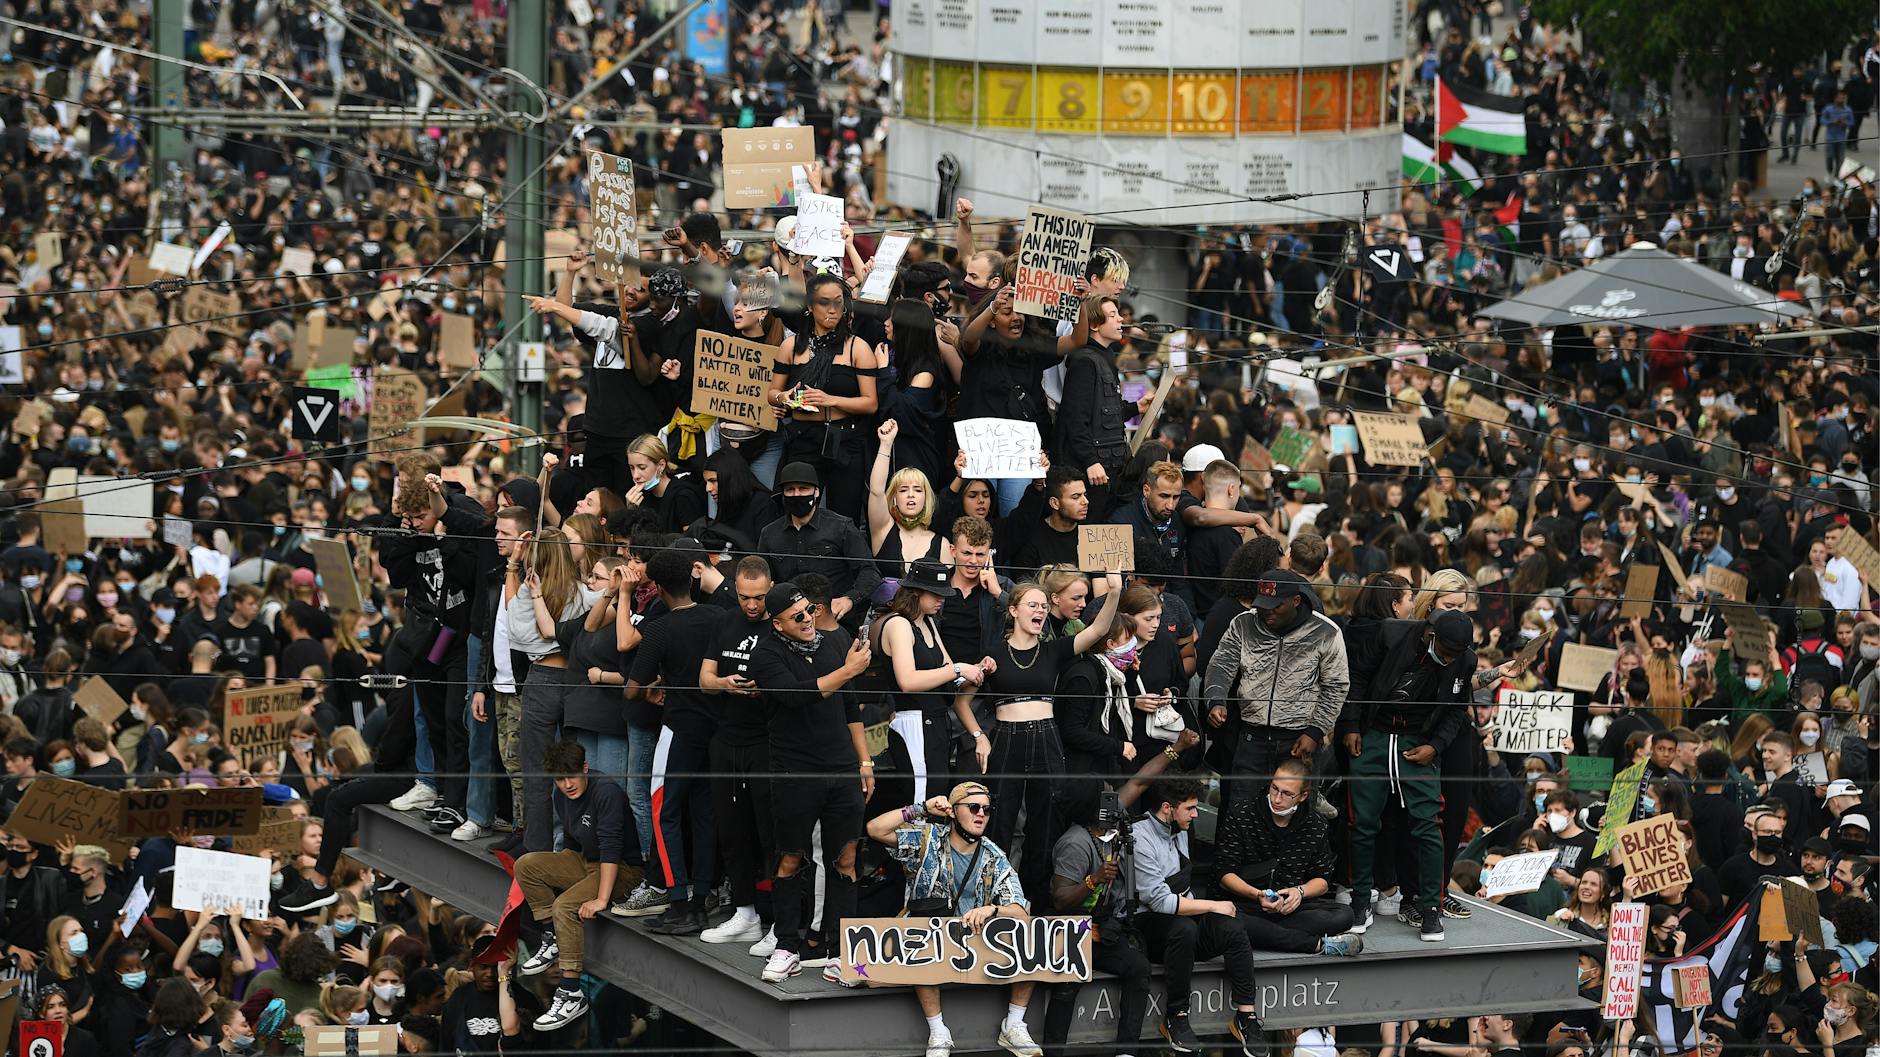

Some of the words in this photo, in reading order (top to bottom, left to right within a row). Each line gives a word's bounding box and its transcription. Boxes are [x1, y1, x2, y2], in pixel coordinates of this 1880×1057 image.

[999, 76, 1026, 116] 7
[1058, 81, 1086, 119] 8
[1121, 80, 1152, 120] 9
[1177, 81, 1228, 121] 10
[1245, 82, 1278, 121] 11
[597, 186, 631, 211] mus
[595, 199, 617, 227] ist
[1032, 213, 1064, 236] THIS
[1066, 218, 1095, 240] ISN'T
[1023, 233, 1041, 250] AN
[1021, 251, 1049, 269] CAN
[1052, 256, 1086, 277] THING
[1018, 267, 1057, 290] BLACK
[1016, 284, 1059, 305] MATTER
[1043, 304, 1077, 322] WHERE
[702, 337, 724, 357] NO
[728, 343, 762, 364] LIVES
[699, 356, 741, 376] MATTER
[749, 365, 772, 382] UNTIL
[697, 376, 730, 392] BLACK
[736, 384, 761, 397] LIVES
[965, 424, 1024, 438] BLACK
[1361, 415, 1408, 426] RACISM
[1365, 426, 1378, 435] IS
[971, 455, 1042, 475] MATTER
[1086, 528, 1120, 542] BLACK
[1104, 541, 1128, 553] LIVES
[1088, 551, 1132, 567] MATTER
[729, 651, 743, 659] BLACK
[231, 698, 244, 716] NO
[246, 696, 269, 715] LIVES
[1509, 692, 1564, 712] BLACK
[230, 725, 269, 746] BLACK
[1506, 728, 1568, 750] MATTER
[38, 781, 97, 808] BLACK
[128, 793, 169, 810] NO
[23, 800, 90, 830] LIVES
[128, 811, 169, 831] NO
[182, 809, 246, 828] PRIDE
[1621, 821, 1678, 855] BLACK
[1629, 844, 1680, 874] LIVES
[1614, 908, 1642, 923] DON'T
[1612, 927, 1630, 941] CALL
[1632, 927, 1643, 942] THE
[982, 917, 1091, 981] SUCK
[1610, 943, 1640, 961] POLICE
[1610, 976, 1635, 992] CALL
[1690, 979, 1702, 990] NOT
[1614, 995, 1633, 1003] YOUR
[1607, 1003, 1634, 1017] MUM
[23, 1023, 38, 1034] NO
[43, 1023, 58, 1034] TO
